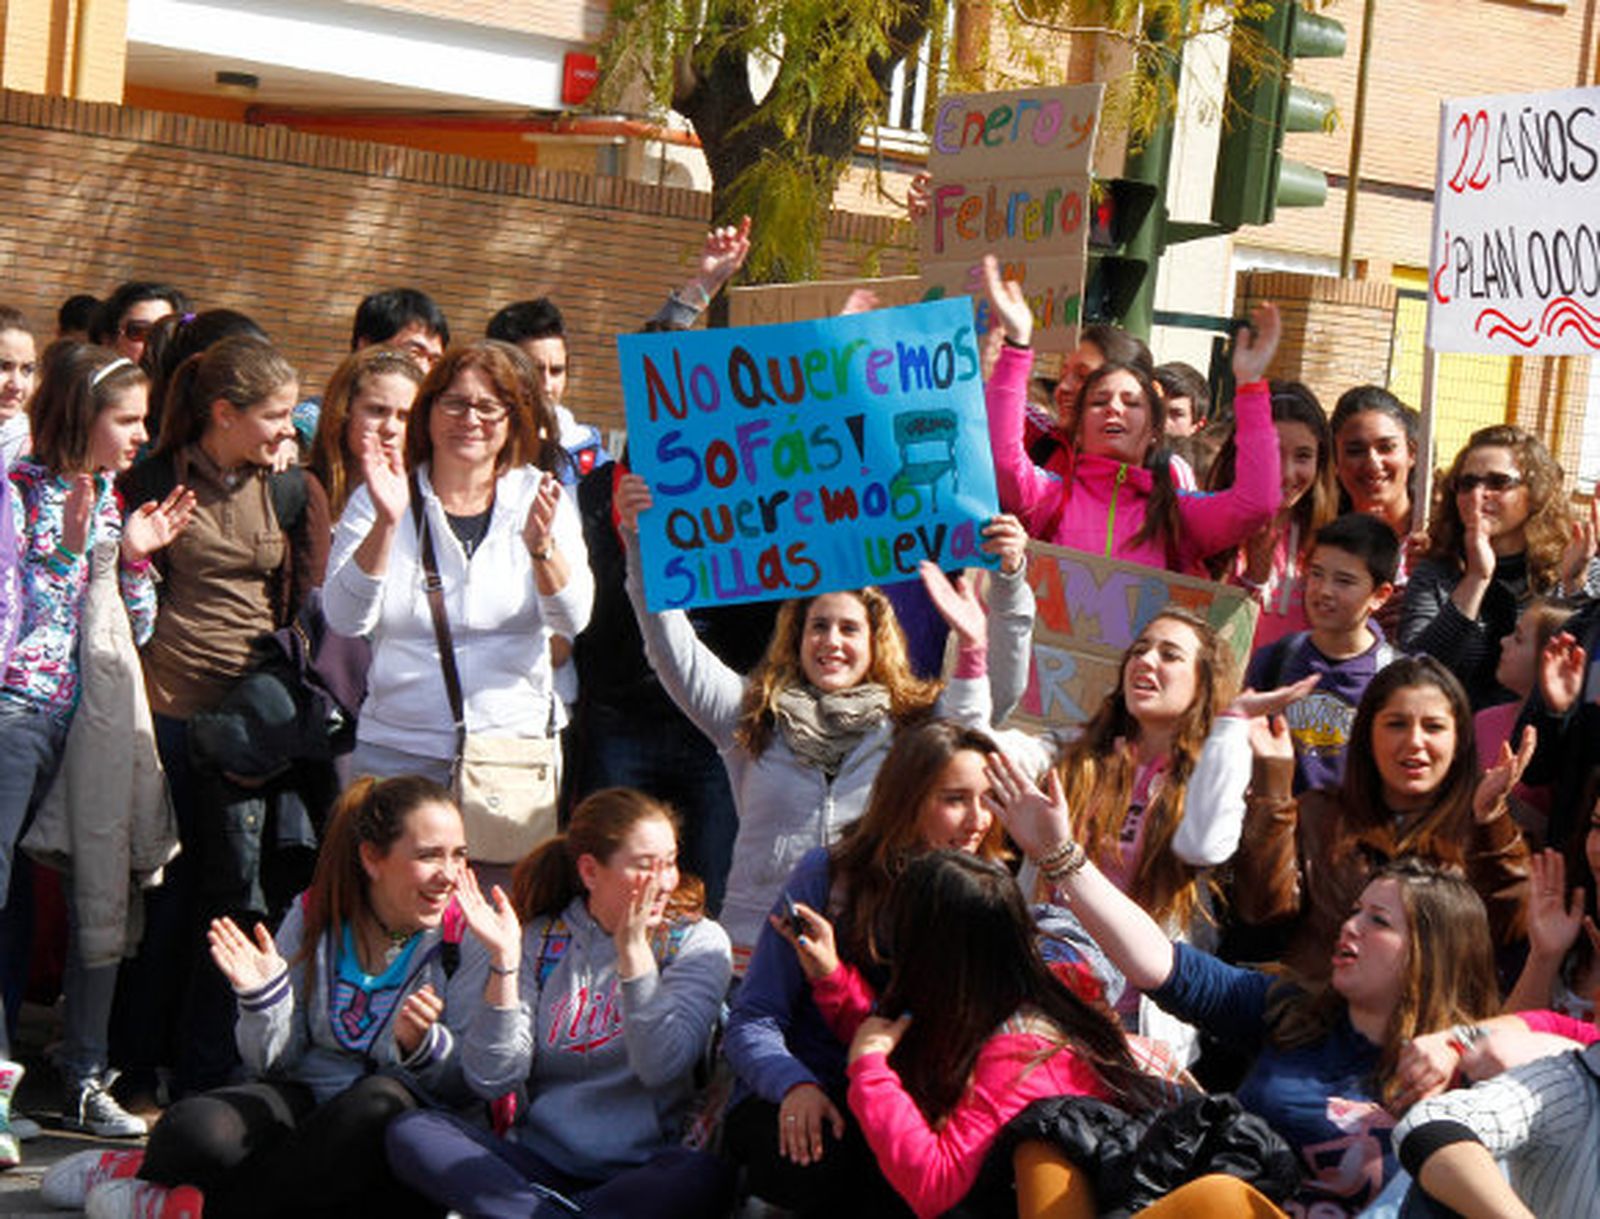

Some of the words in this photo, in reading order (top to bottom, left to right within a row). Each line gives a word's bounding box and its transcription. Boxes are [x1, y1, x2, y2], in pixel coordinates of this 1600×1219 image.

[933, 99, 1063, 156] Enero
[1066, 114, 1095, 149] y
[1448, 109, 1491, 194] 22
[1497, 106, 1599, 185] AÑOS
[934, 184, 1082, 253] Febrero
[642, 346, 722, 423] No
[727, 325, 978, 409] Queremos
